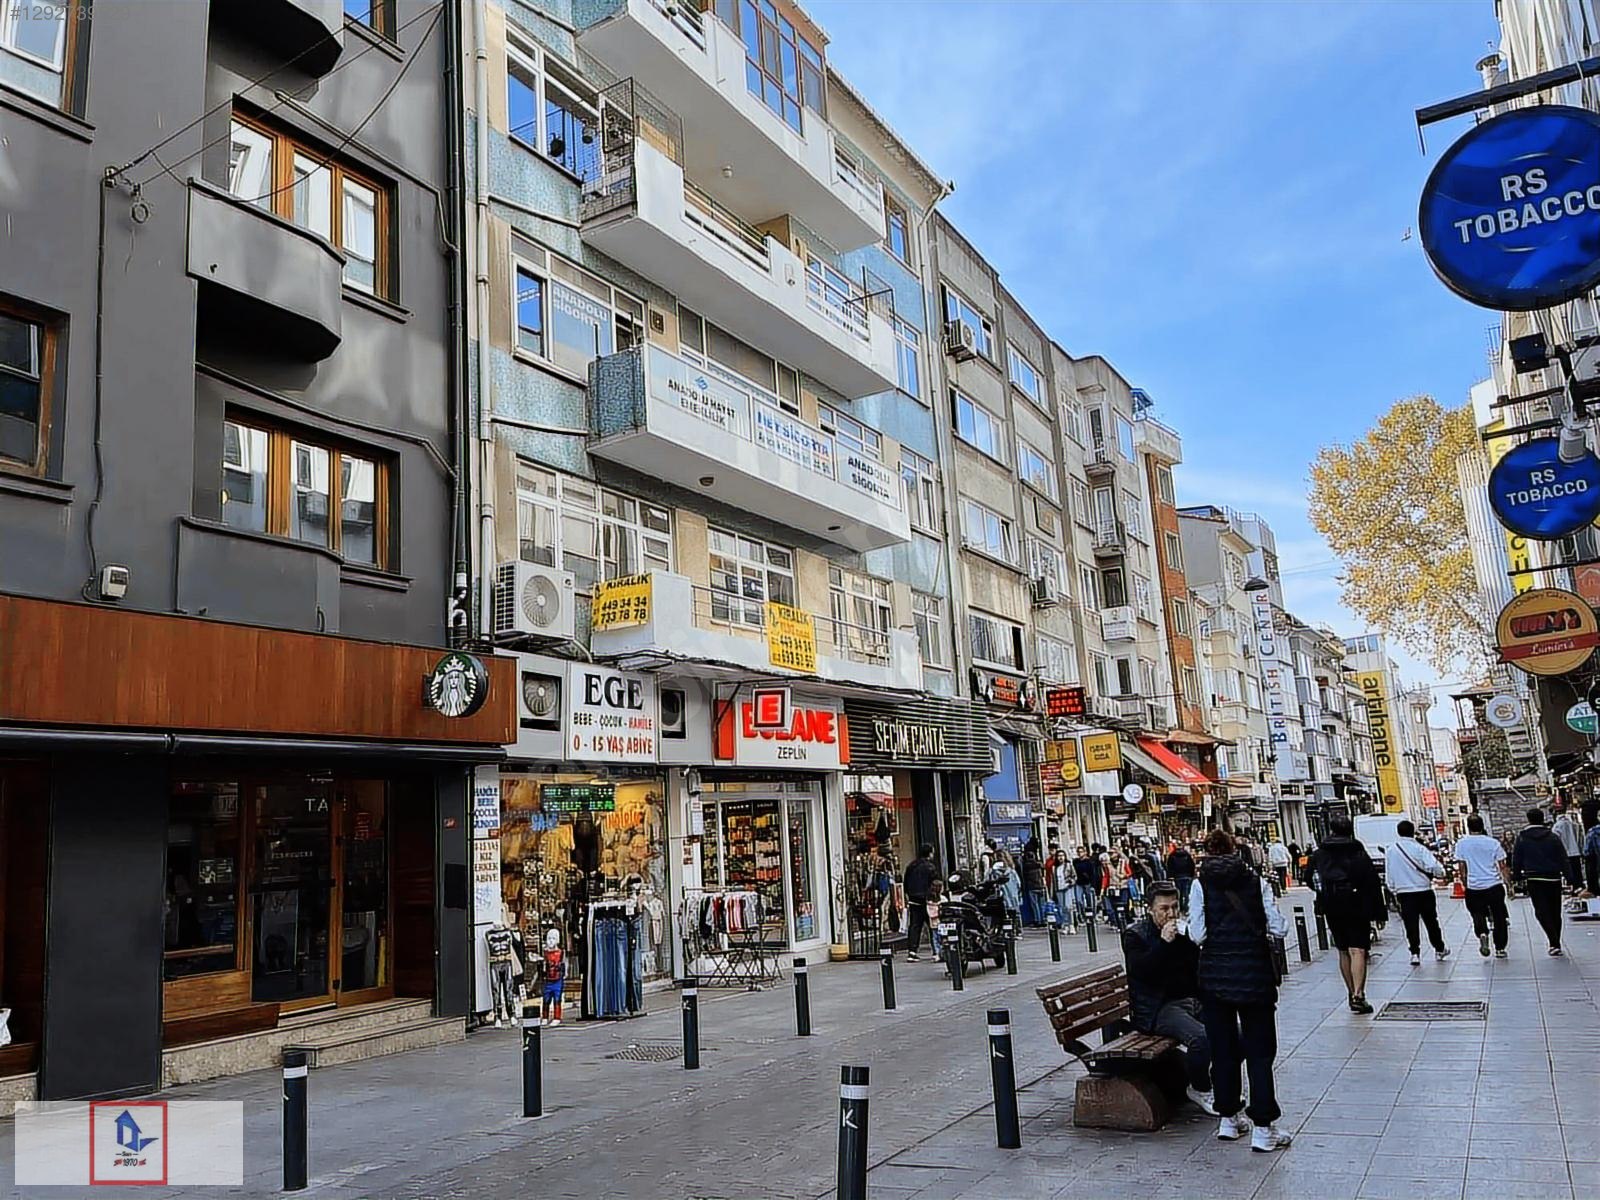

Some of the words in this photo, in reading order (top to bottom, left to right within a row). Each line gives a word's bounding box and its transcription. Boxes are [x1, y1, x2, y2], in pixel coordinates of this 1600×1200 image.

[1501, 168, 1548, 201] RS
[1454, 185, 1600, 243] TOBACCO
[1530, 469, 1556, 485] RS
[1506, 479, 1588, 506] TOBACCO
[620, 598, 631, 609] 34
[634, 596, 647, 607] 34
[634, 609, 647, 620] 78
[584, 673, 644, 710] EGE
[761, 696, 779, 722] E
[1268, 667, 1287, 742] BRITISH
[573, 712, 592, 726] BEBE
[593, 735, 604, 752] 15
[606, 736, 624, 758] YAŞ
[626, 733, 653, 755] ABİYE
[777, 745, 807, 760] ZEPLİN
